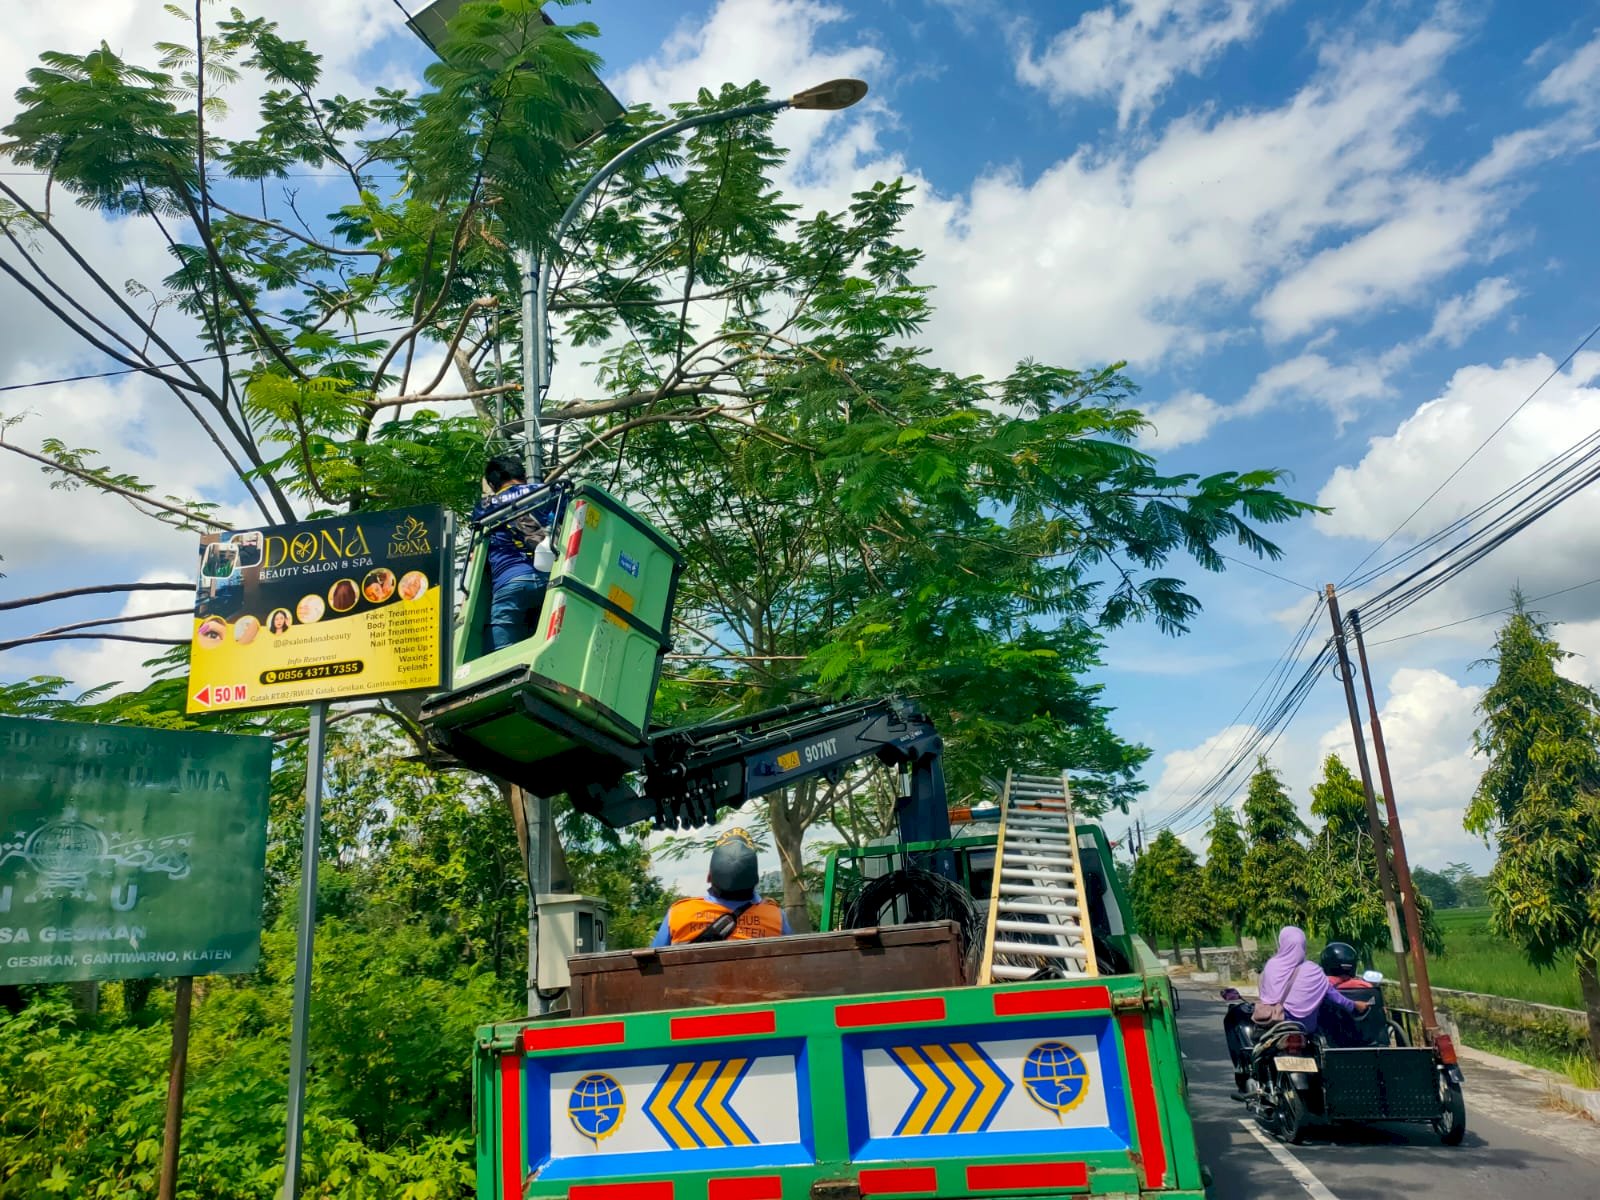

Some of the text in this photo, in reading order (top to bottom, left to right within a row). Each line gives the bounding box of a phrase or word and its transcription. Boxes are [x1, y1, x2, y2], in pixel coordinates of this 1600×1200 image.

[264, 525, 372, 568] DONA
[388, 538, 431, 555] DONA
[259, 567, 299, 580] BEAUTY
[302, 561, 338, 574] SALON
[352, 557, 374, 569] SPA
[388, 607, 428, 618] Treatment
[367, 617, 428, 630] Body Treatment
[370, 626, 428, 639] Hair Treatment
[370, 635, 428, 648] Nail Treatment
[394, 644, 428, 654] Make Up
[399, 654, 428, 662] Waxing
[278, 662, 358, 681] 0856 4371 7355
[398, 663, 428, 673] Eyelash
[215, 686, 246, 702] 50 M
[805, 737, 837, 763] 907NT
[39, 926, 147, 943] GESIKAN
[7, 949, 232, 968] GESIKAN, GANTIWARNO, KLATEN
